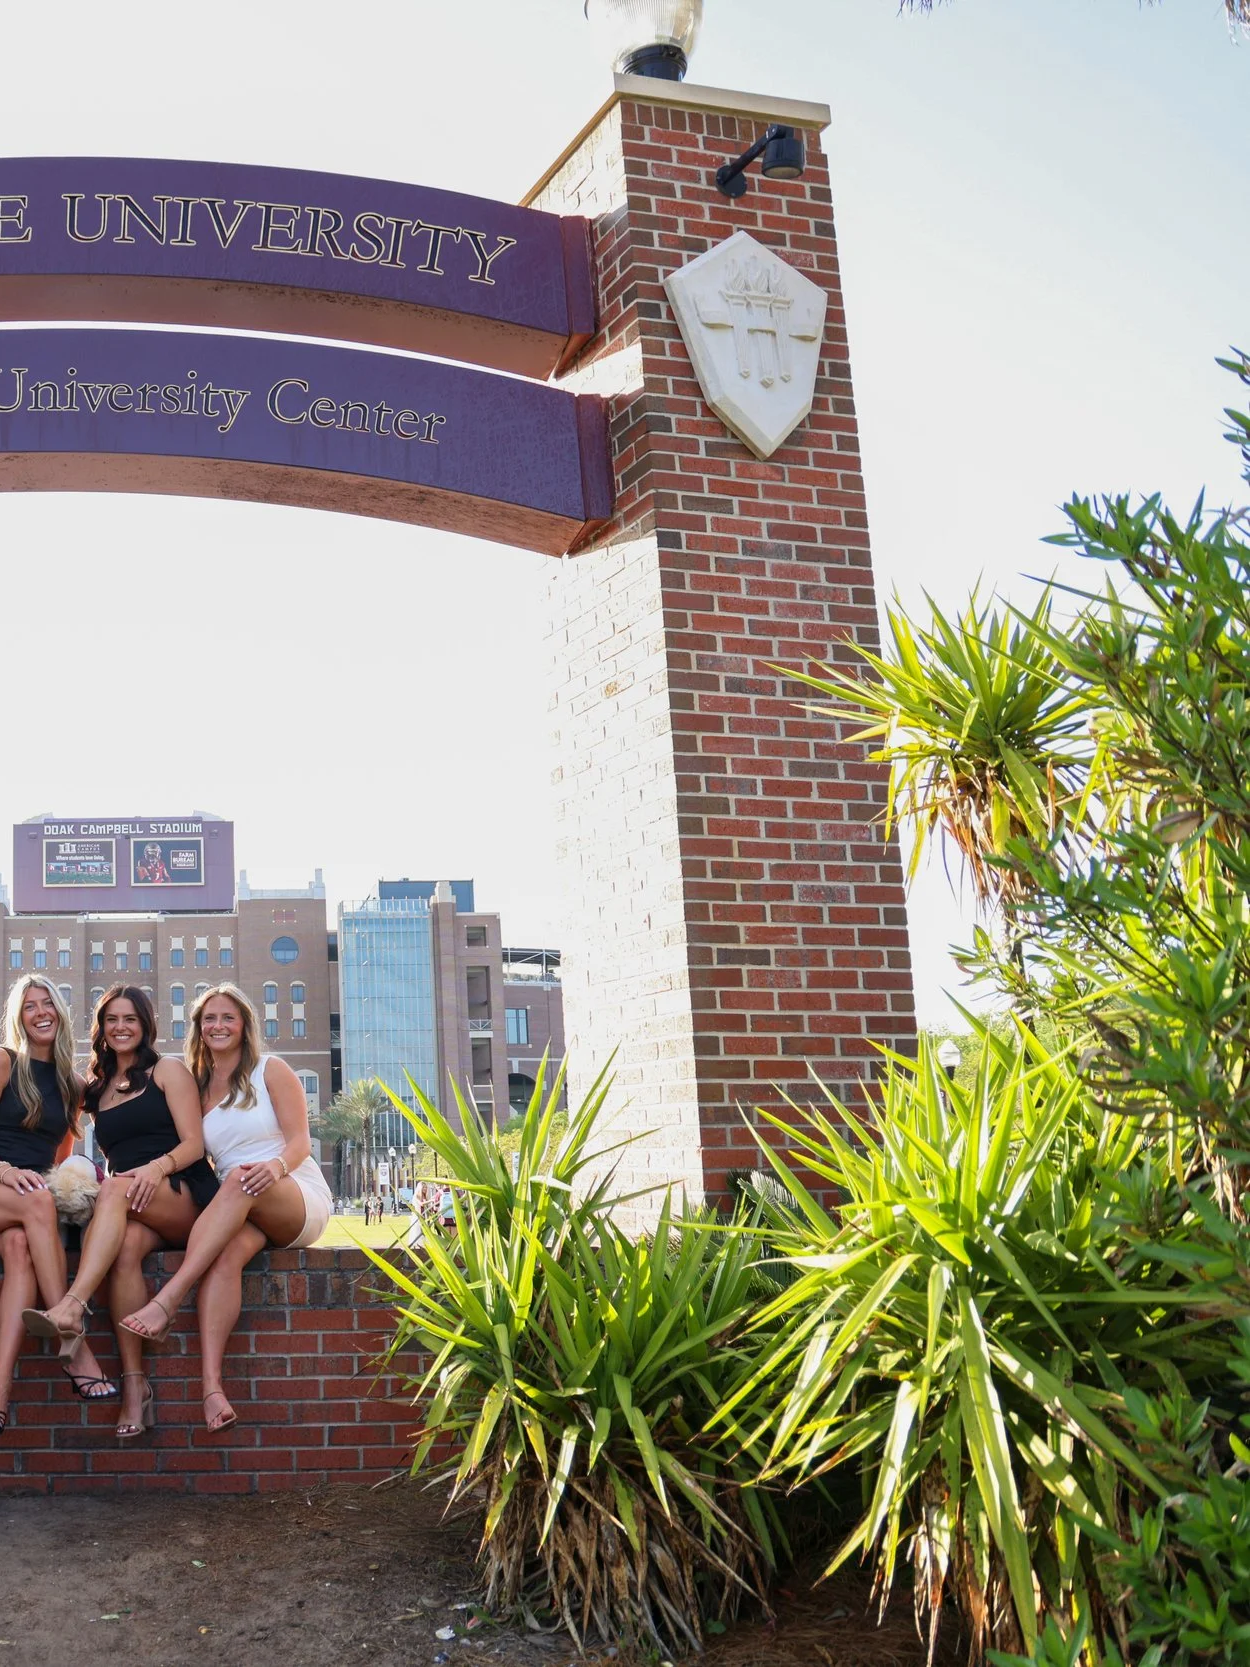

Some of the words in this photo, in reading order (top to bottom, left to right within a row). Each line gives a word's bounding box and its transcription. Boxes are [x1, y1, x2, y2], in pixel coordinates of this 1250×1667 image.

[62, 194, 516, 285] UNIVERSITY
[267, 379, 446, 444] Center
[44, 824, 75, 835] DOAK
[80, 823, 143, 835] CAMPBELL
[150, 822, 202, 834] STADIUM
